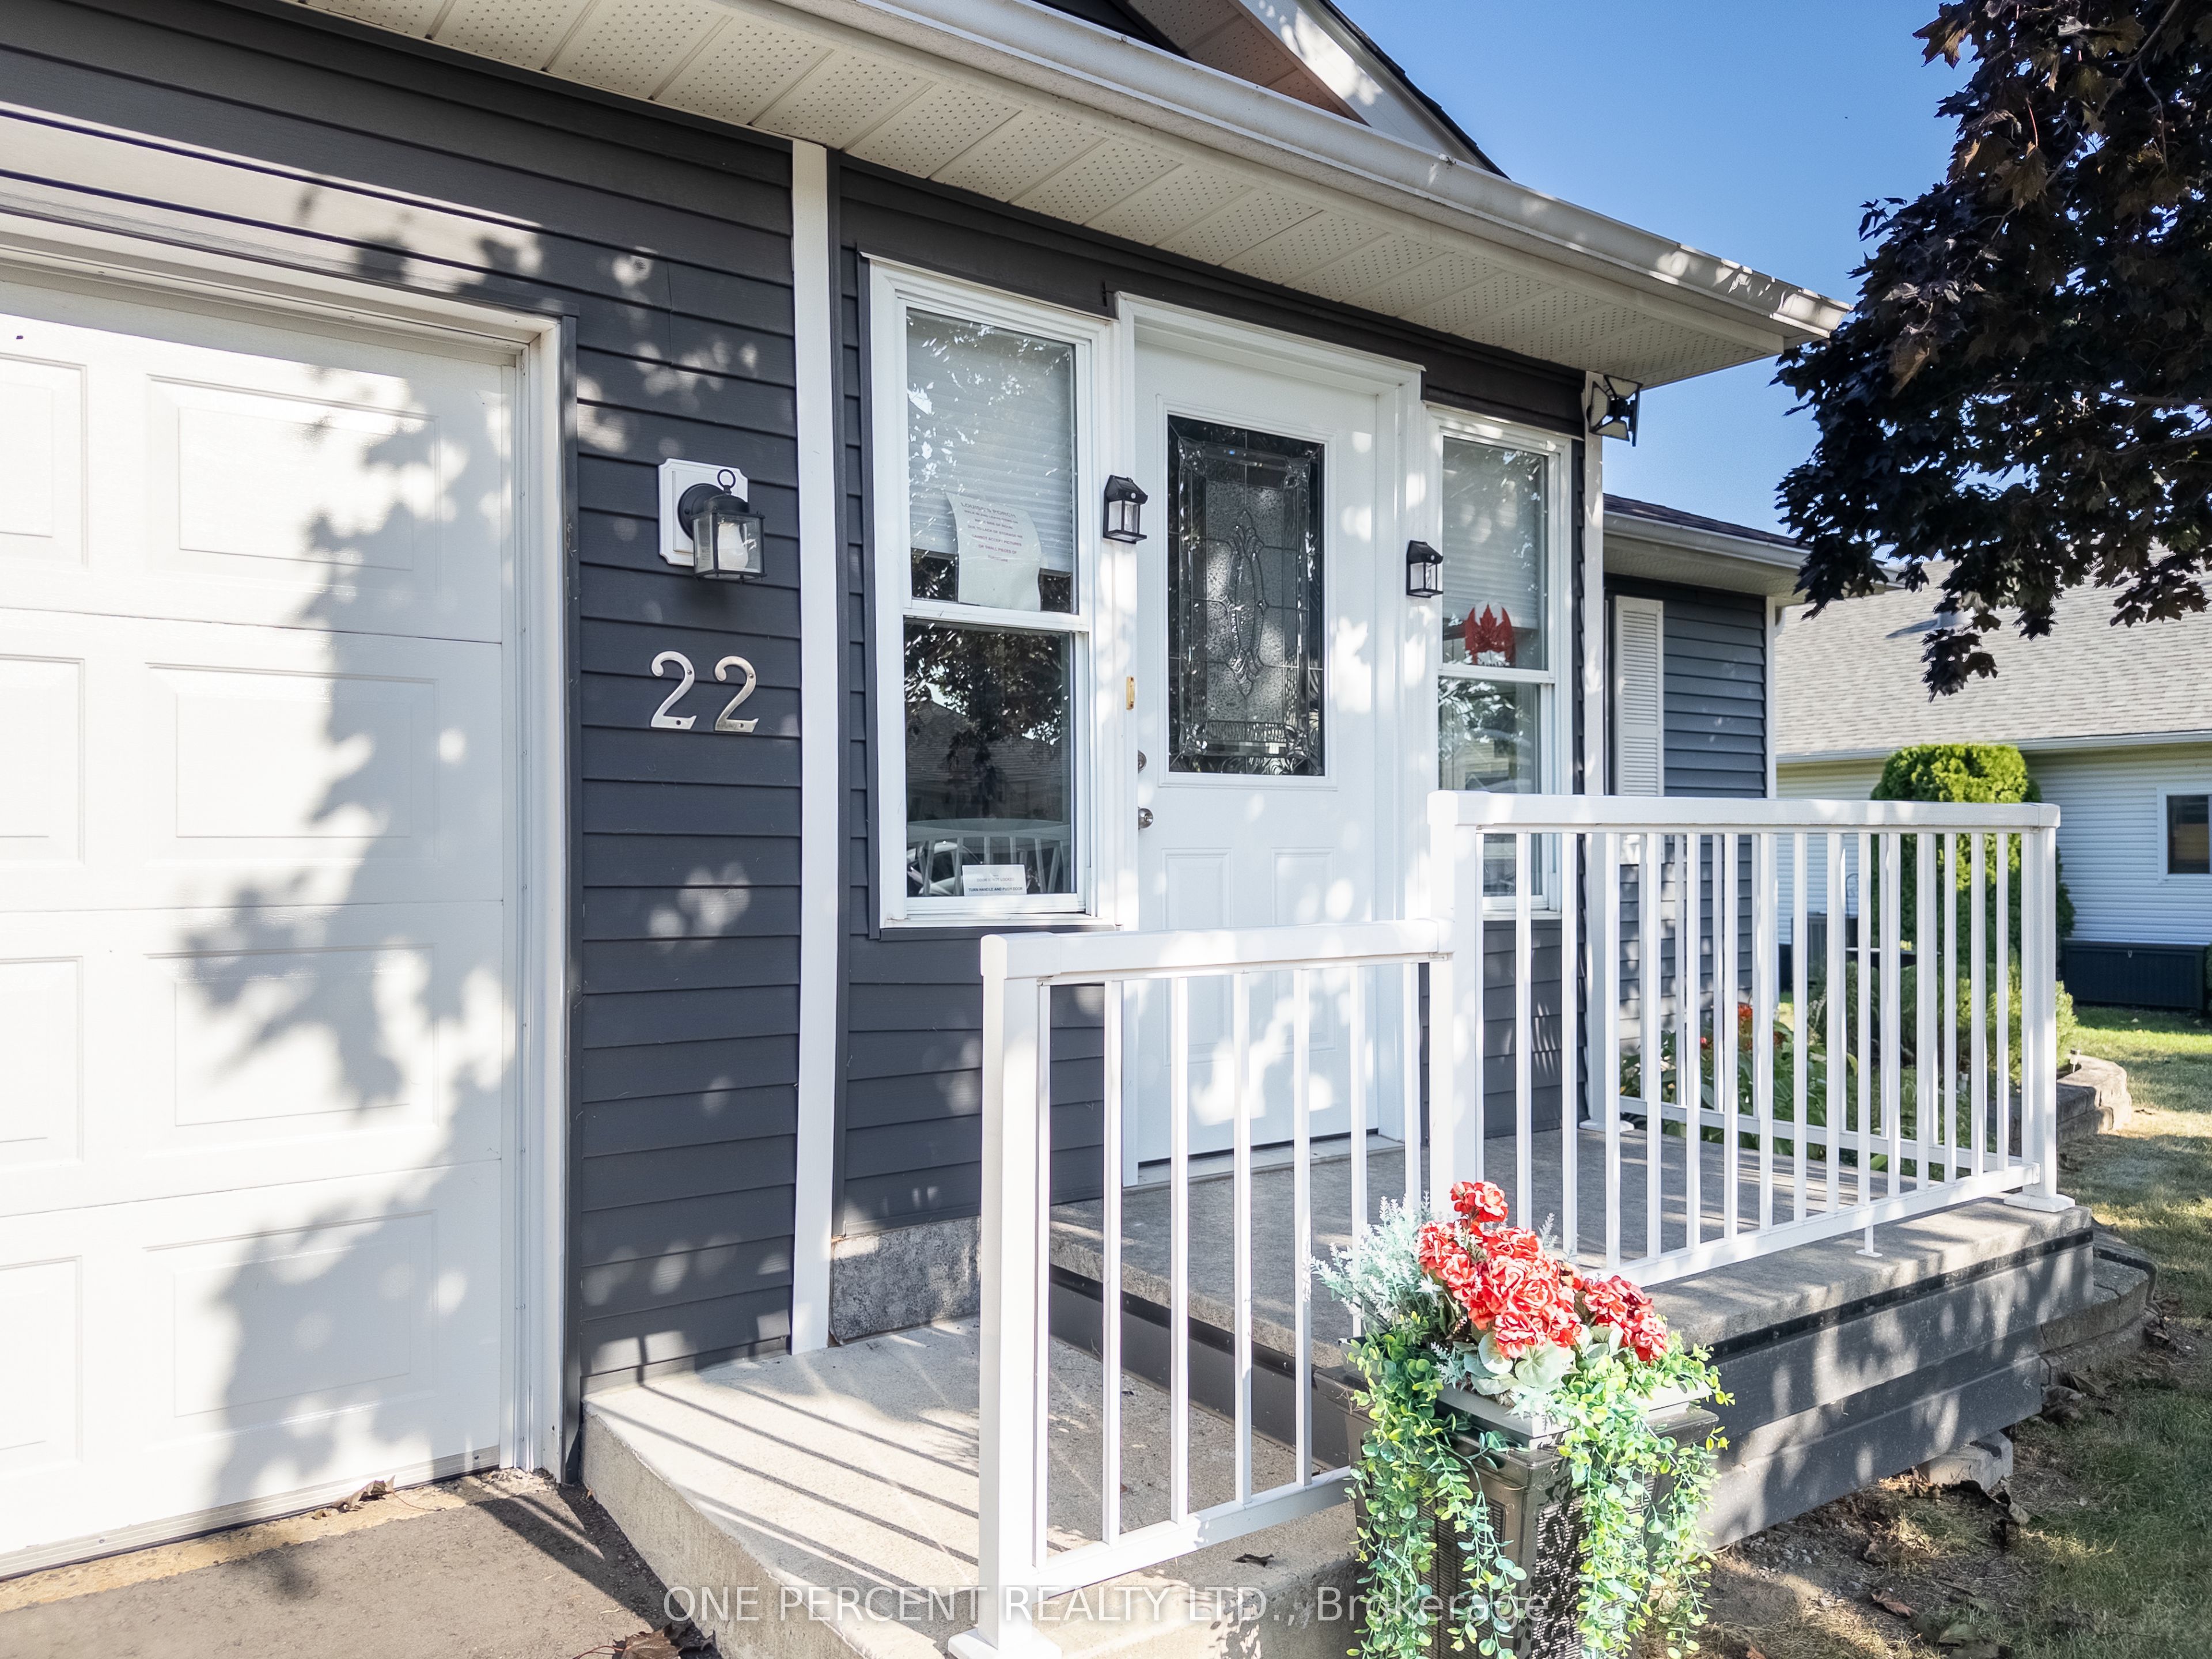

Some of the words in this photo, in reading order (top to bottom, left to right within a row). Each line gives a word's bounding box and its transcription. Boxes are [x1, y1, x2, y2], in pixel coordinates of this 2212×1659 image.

[960, 502, 991, 513] LOUISE'S
[992, 509, 1017, 518] PORCH
[650, 650, 759, 733] 22
